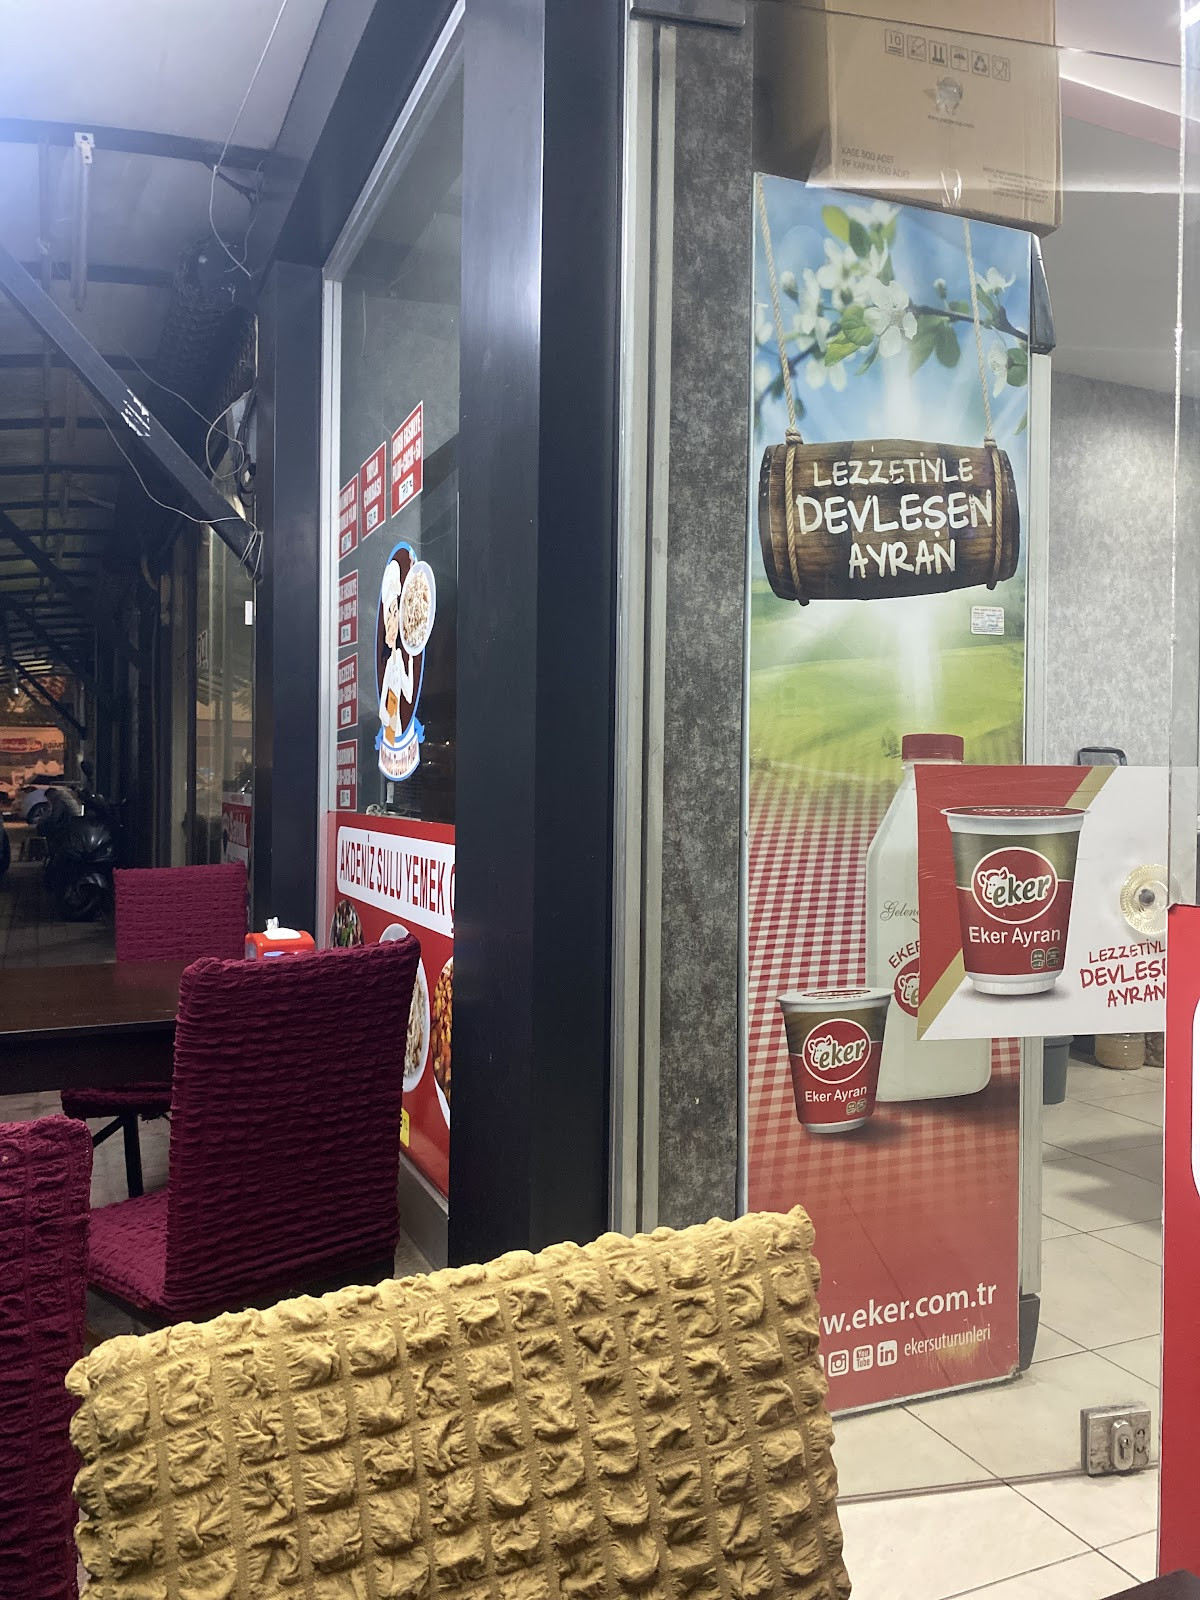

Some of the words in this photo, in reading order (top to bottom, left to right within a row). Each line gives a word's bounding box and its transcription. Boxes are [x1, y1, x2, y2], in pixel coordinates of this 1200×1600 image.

[813, 452, 973, 487] LEZZETİYLE
[796, 489, 993, 538] DEVLEŞEN
[849, 538, 956, 578] AYRAN
[340, 834, 375, 890] AKDENİZ
[377, 848, 402, 900] SULU
[405, 853, 446, 915] YEMEK
[993, 876, 1050, 906] eker
[969, 927, 1008, 944] Eker
[1012, 927, 1061, 948] Ayran
[1107, 981, 1165, 1008] AYRAN
[819, 1040, 866, 1068] eker
[805, 1090, 832, 1103] Eker
[834, 1086, 867, 1103] Ayran
[819, 1282, 997, 1335] w.eker.com.tr
[904, 1323, 991, 1356] ekersuturunleri
